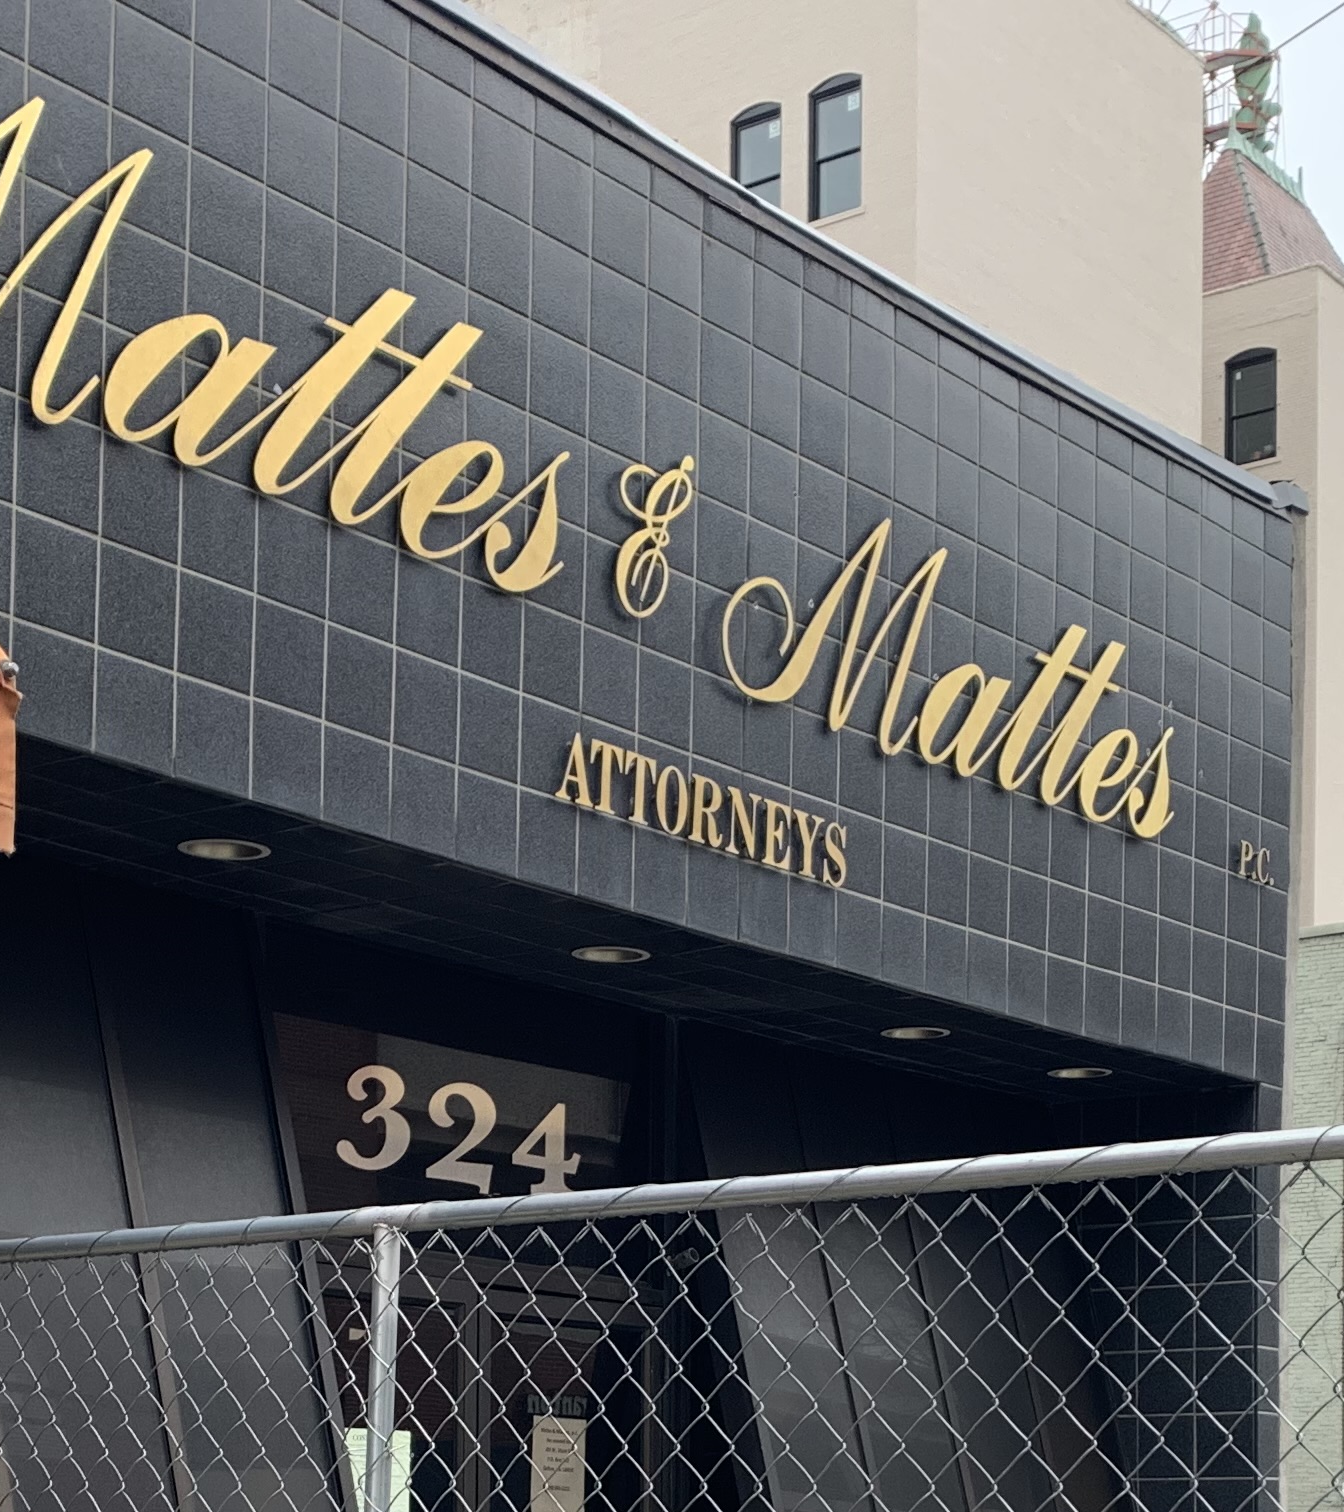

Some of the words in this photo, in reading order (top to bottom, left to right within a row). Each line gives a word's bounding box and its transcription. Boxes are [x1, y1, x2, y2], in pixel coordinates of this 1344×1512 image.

[614, 454, 695, 618] &
[722, 518, 1175, 838] Mattes
[554, 731, 847, 888] ATTORNEYS
[1238, 839, 1275, 886] P.C.
[336, 1063, 582, 1195] 324
